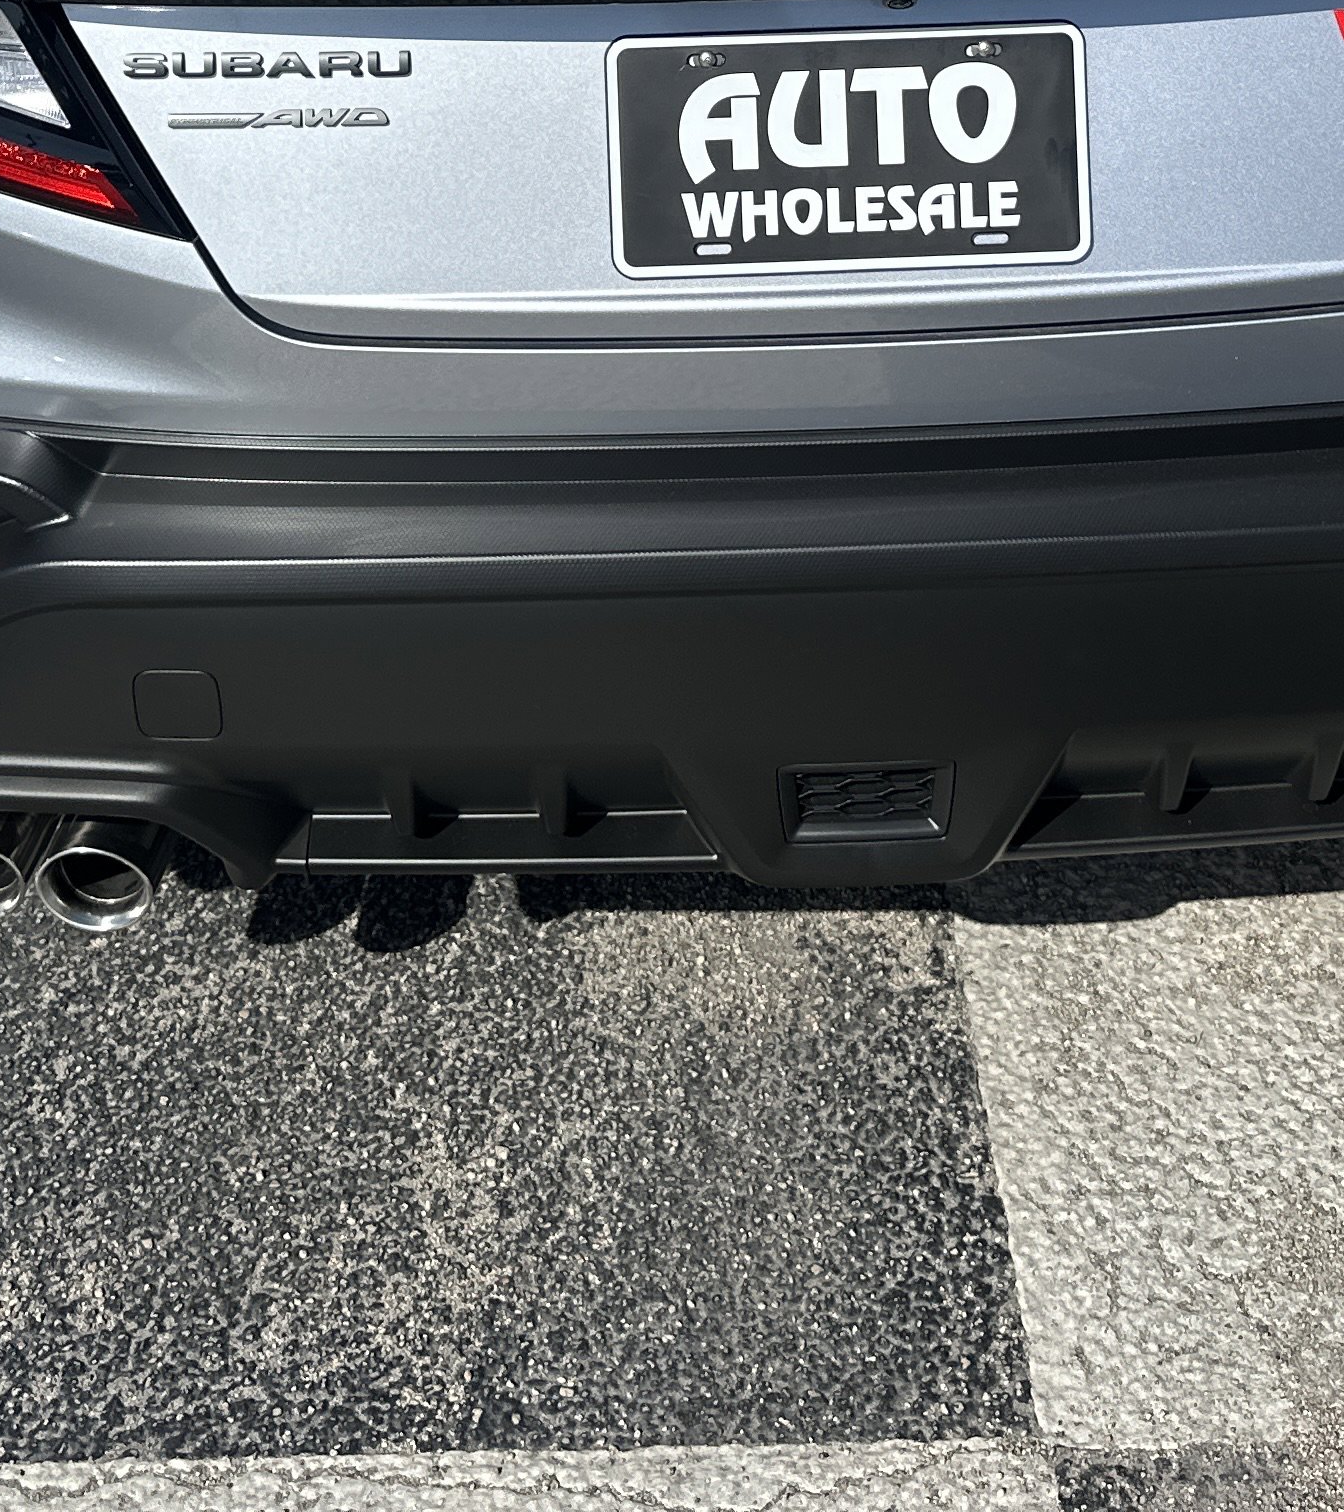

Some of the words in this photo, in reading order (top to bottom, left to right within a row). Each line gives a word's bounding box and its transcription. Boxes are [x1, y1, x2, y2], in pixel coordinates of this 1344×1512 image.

[122, 49, 413, 79] SUBARU
[250, 107, 391, 129] AWD
[678, 61, 1017, 185] AUTO
[680, 180, 1021, 243] WHOLESALE
